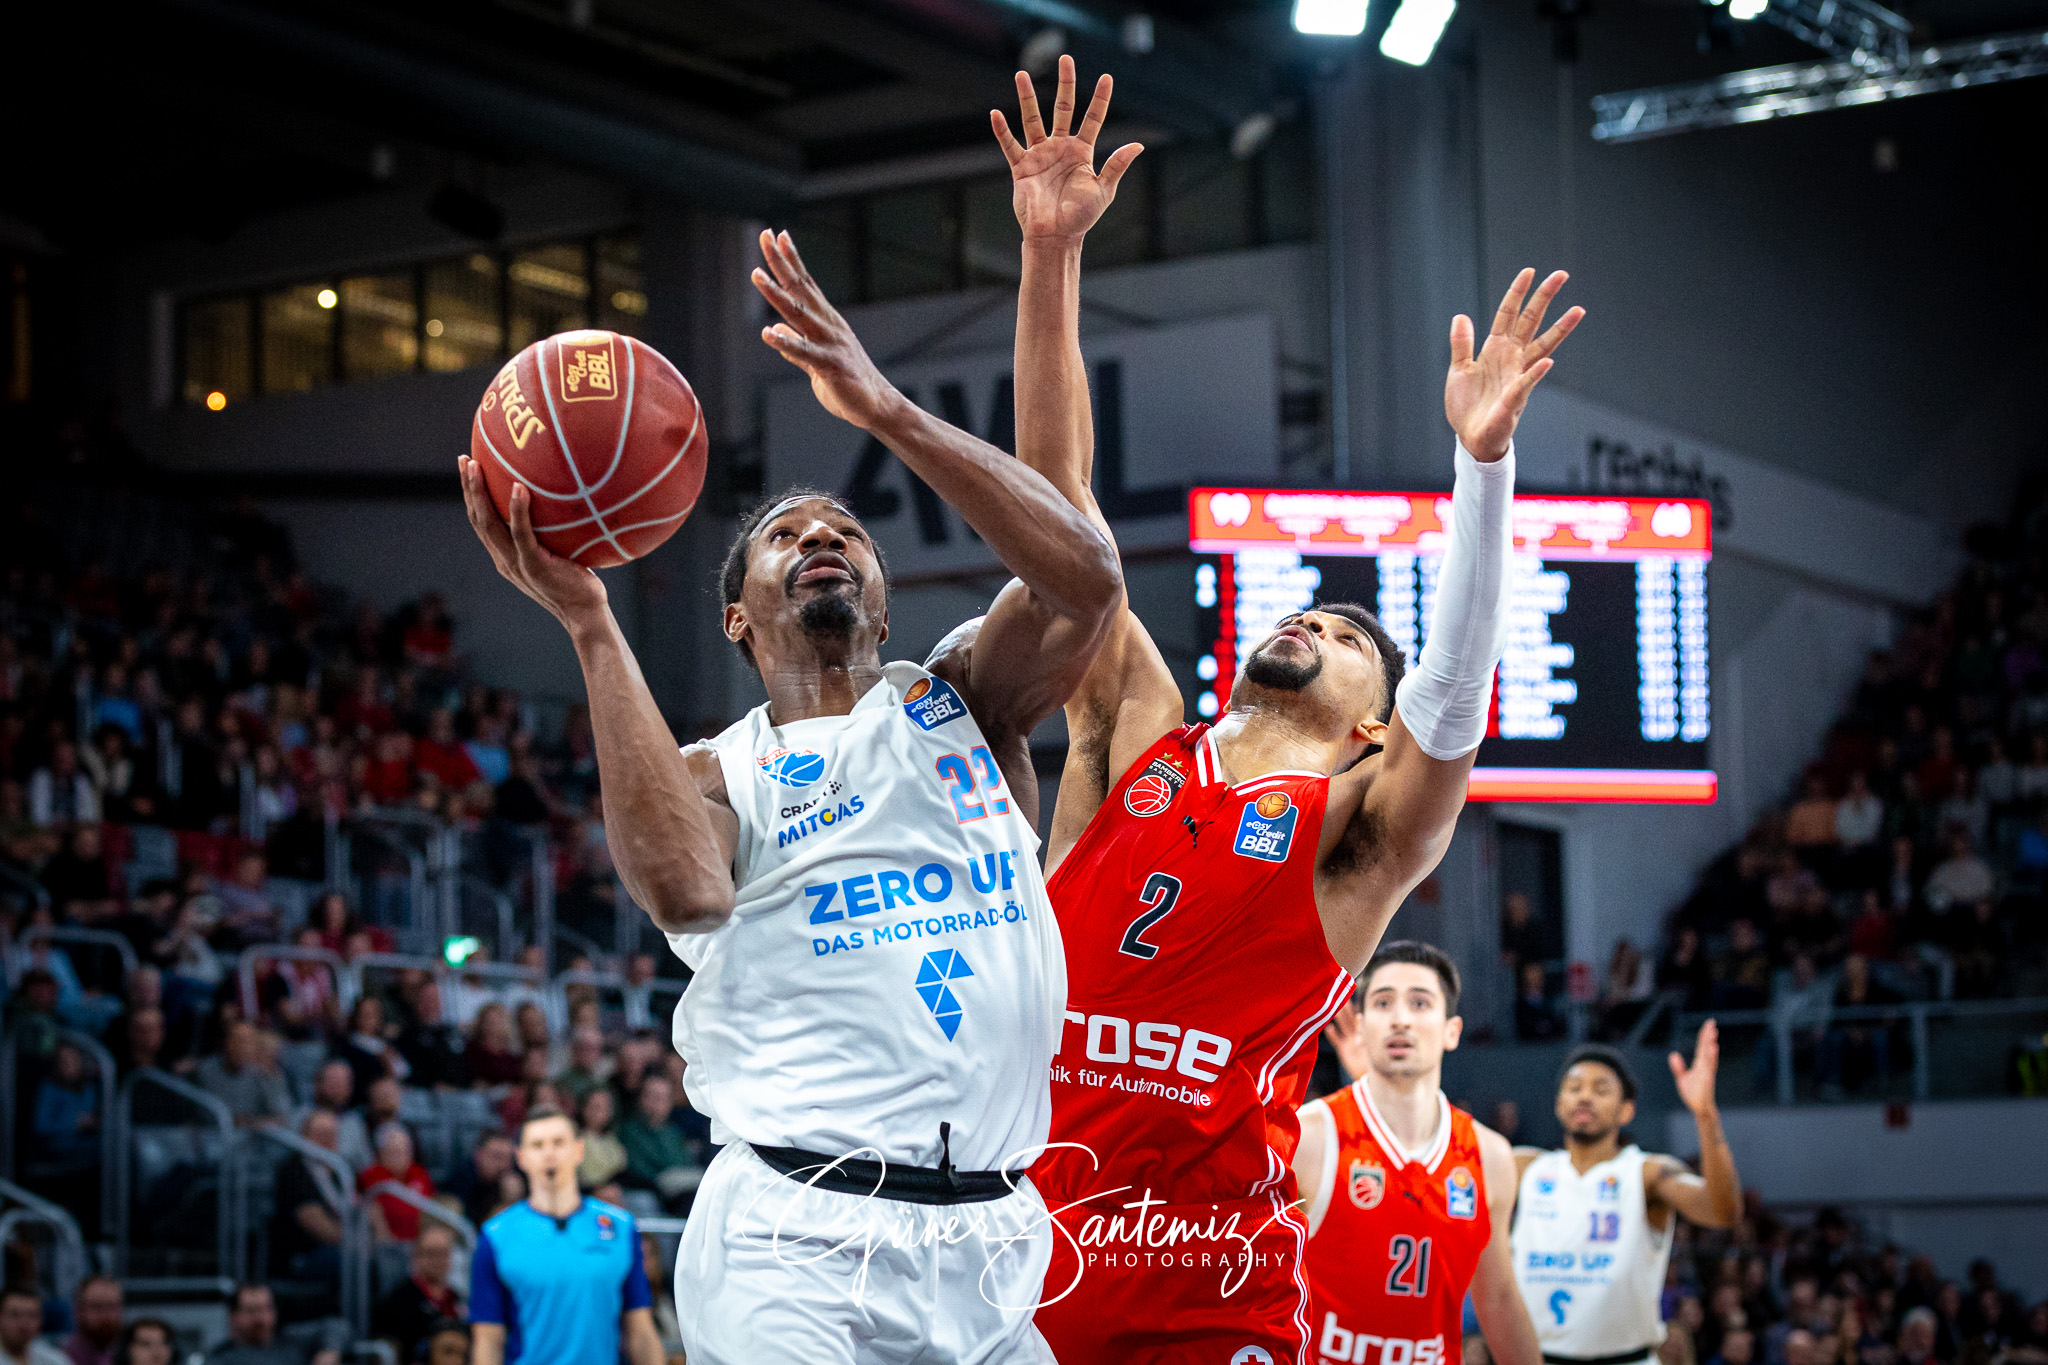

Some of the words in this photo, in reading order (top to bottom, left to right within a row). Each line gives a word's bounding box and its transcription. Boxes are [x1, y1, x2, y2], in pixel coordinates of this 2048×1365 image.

[588, 349, 612, 391] BBL
[921, 700, 960, 726] BBL
[935, 744, 1010, 826] 22
[778, 794, 865, 849] MITGAS
[1240, 834, 1281, 856] BBL
[804, 862, 953, 925] ZERO
[1118, 871, 1183, 960] 2
[812, 931, 864, 957] DAS
[1055, 1009, 1233, 1083] rose
[1077, 1068, 1108, 1088] für
[1385, 1234, 1433, 1298] 21
